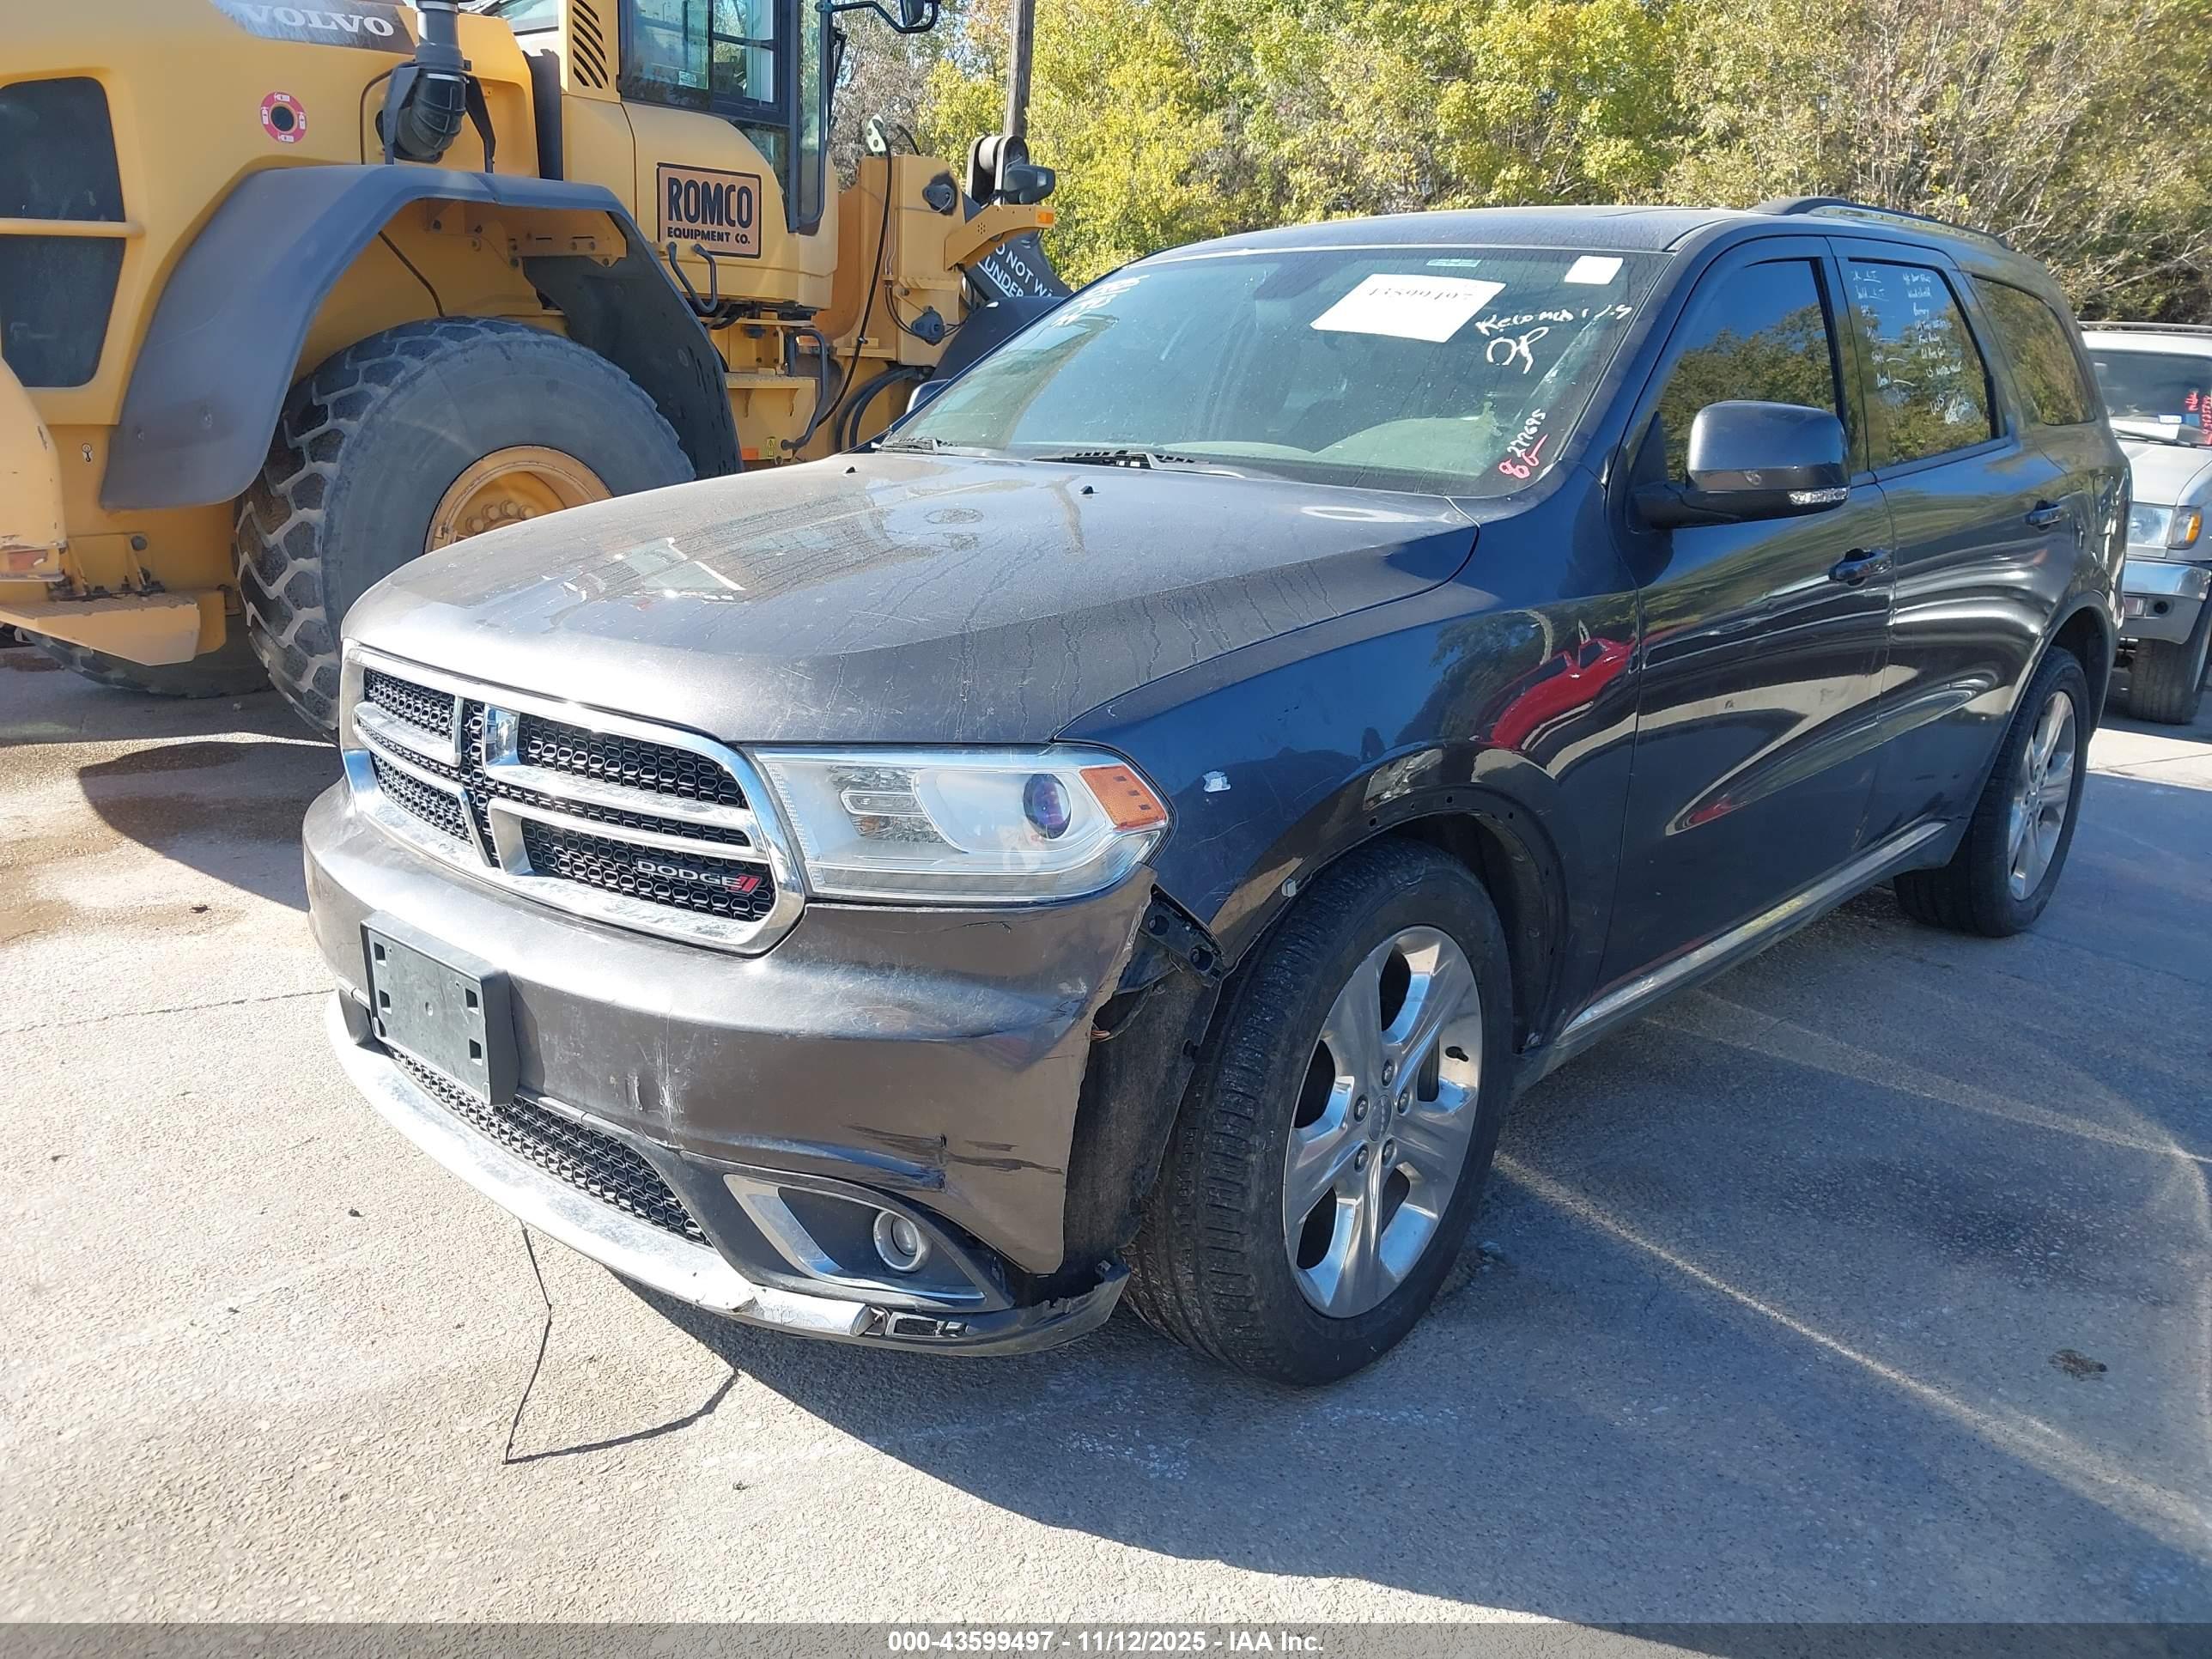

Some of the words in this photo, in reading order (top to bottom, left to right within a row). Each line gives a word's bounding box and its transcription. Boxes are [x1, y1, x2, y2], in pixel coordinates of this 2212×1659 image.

[237, 4, 394, 37] VOLVO
[667, 177, 753, 228] ROMCO
[667, 226, 732, 243] EQUIPMENT
[734, 233, 751, 245] CO.
[985, 255, 1024, 297] UNDER
[1006, 249, 1034, 283] NOT
[637, 860, 743, 889] DODGE
